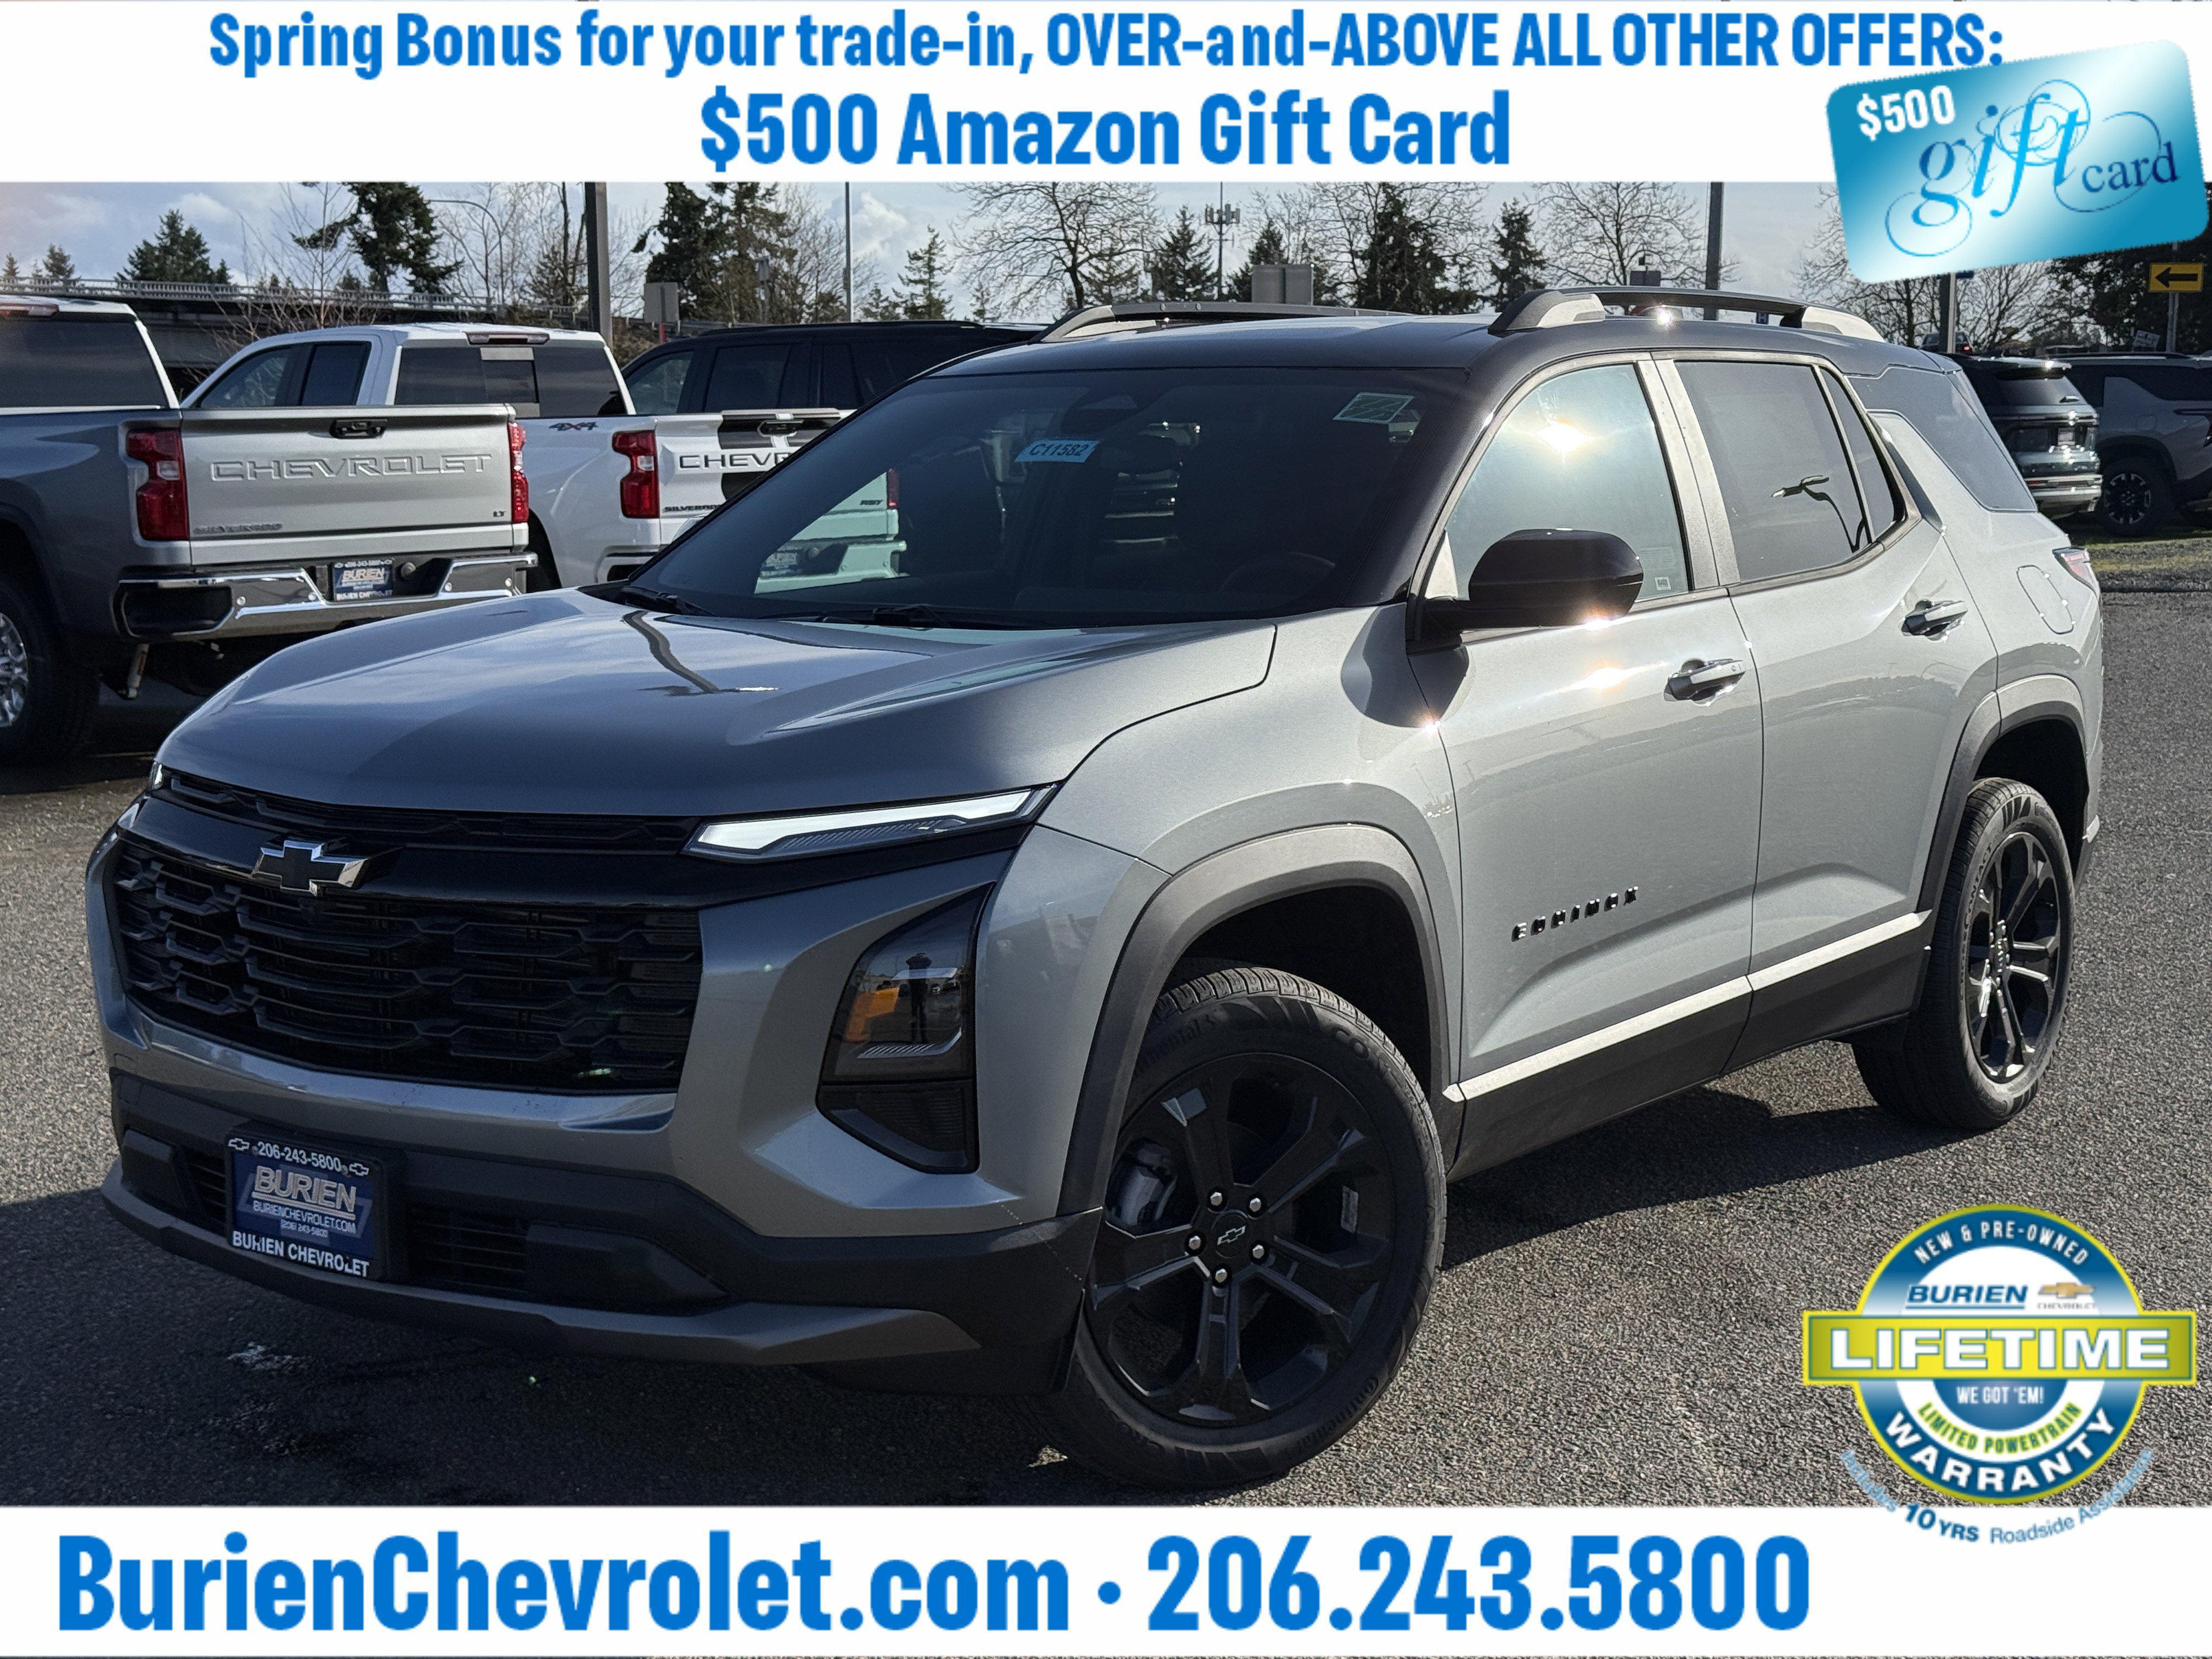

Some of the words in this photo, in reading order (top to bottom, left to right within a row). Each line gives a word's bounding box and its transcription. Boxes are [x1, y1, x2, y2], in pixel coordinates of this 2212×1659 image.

[1029, 443, 1089, 456] C11582
[211, 454, 493, 482] CHEVROLET
[1511, 885, 1639, 943] EQUINOX
[257, 1141, 343, 1172] 206-243-5800
[255, 1165, 357, 1213] BURIEN
